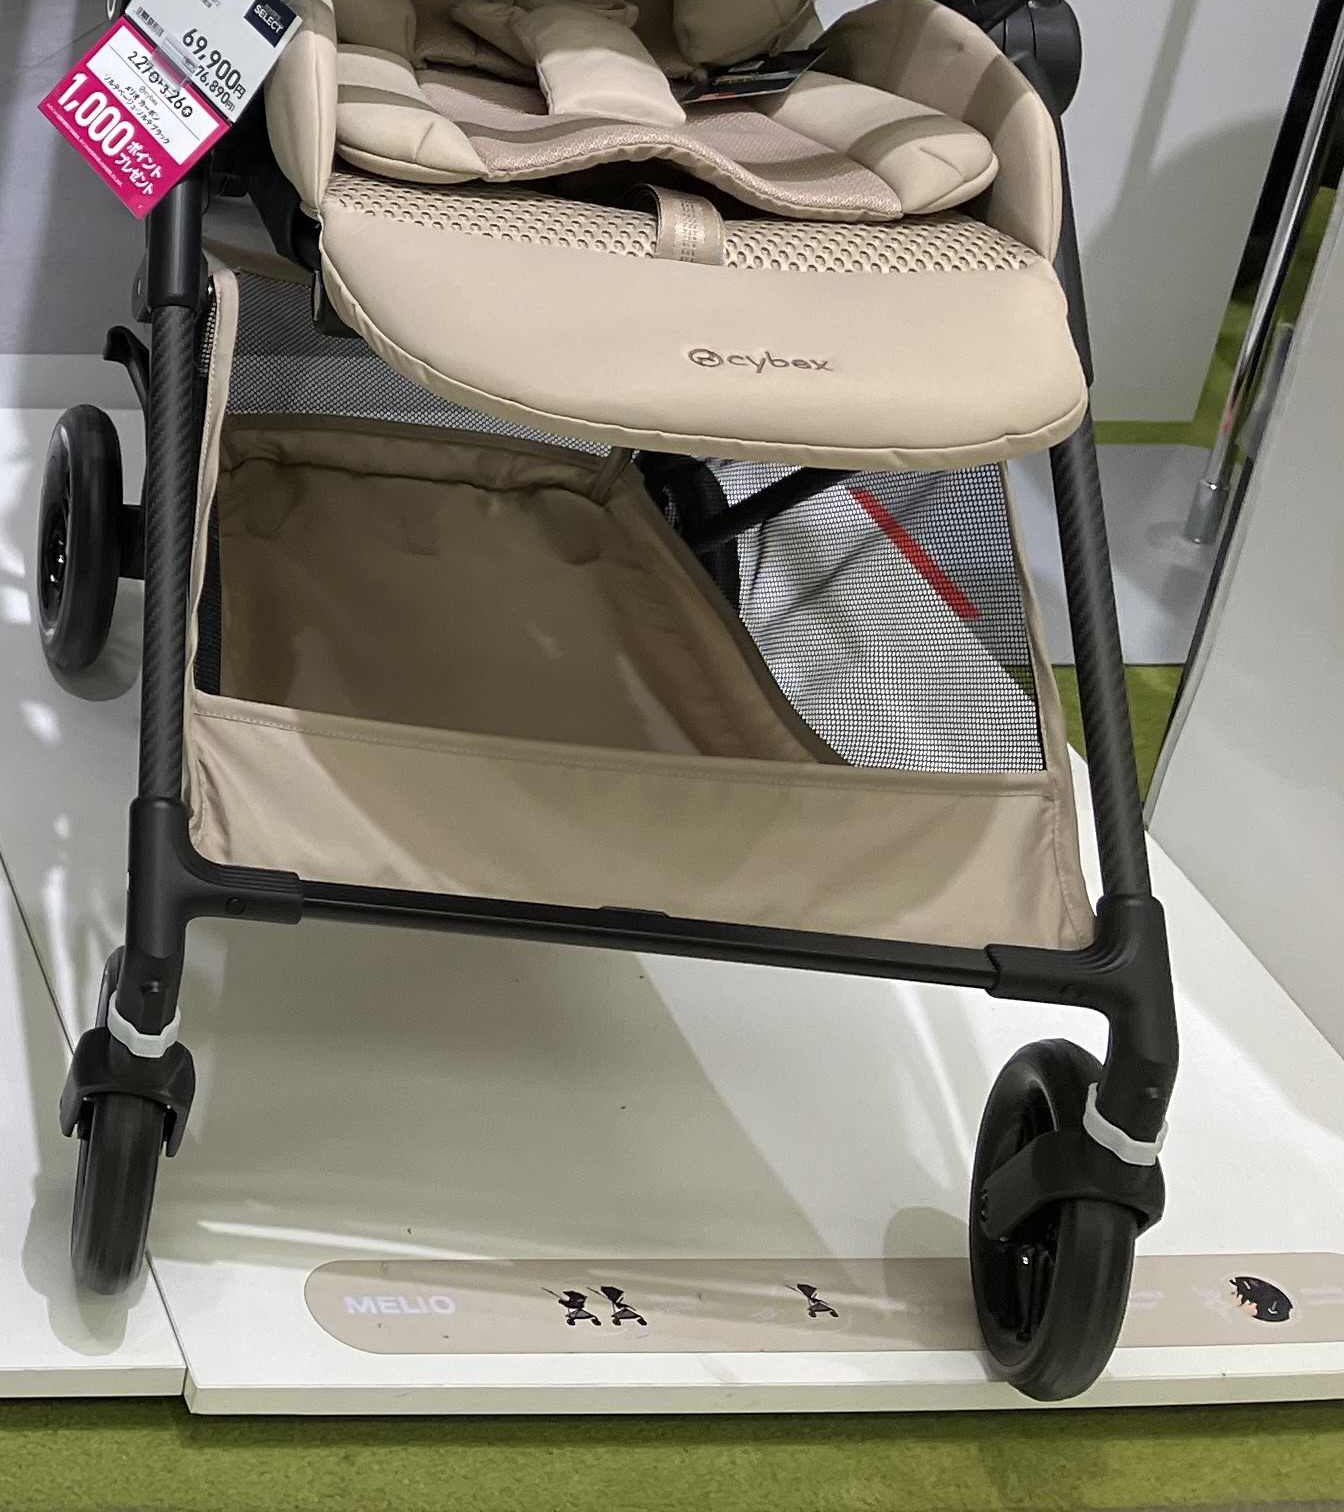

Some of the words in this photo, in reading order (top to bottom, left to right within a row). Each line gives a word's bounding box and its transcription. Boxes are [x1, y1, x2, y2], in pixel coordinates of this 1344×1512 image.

[253, 4, 285, 34] SELECT
[181, 28, 247, 101] 69,900円
[57, 72, 135, 157] 1,000
[114, 151, 154, 195] プレゼント
[126, 140, 162, 179] ポイント
[726, 351, 834, 374] cybex
[343, 1294, 457, 1316] MELIO
